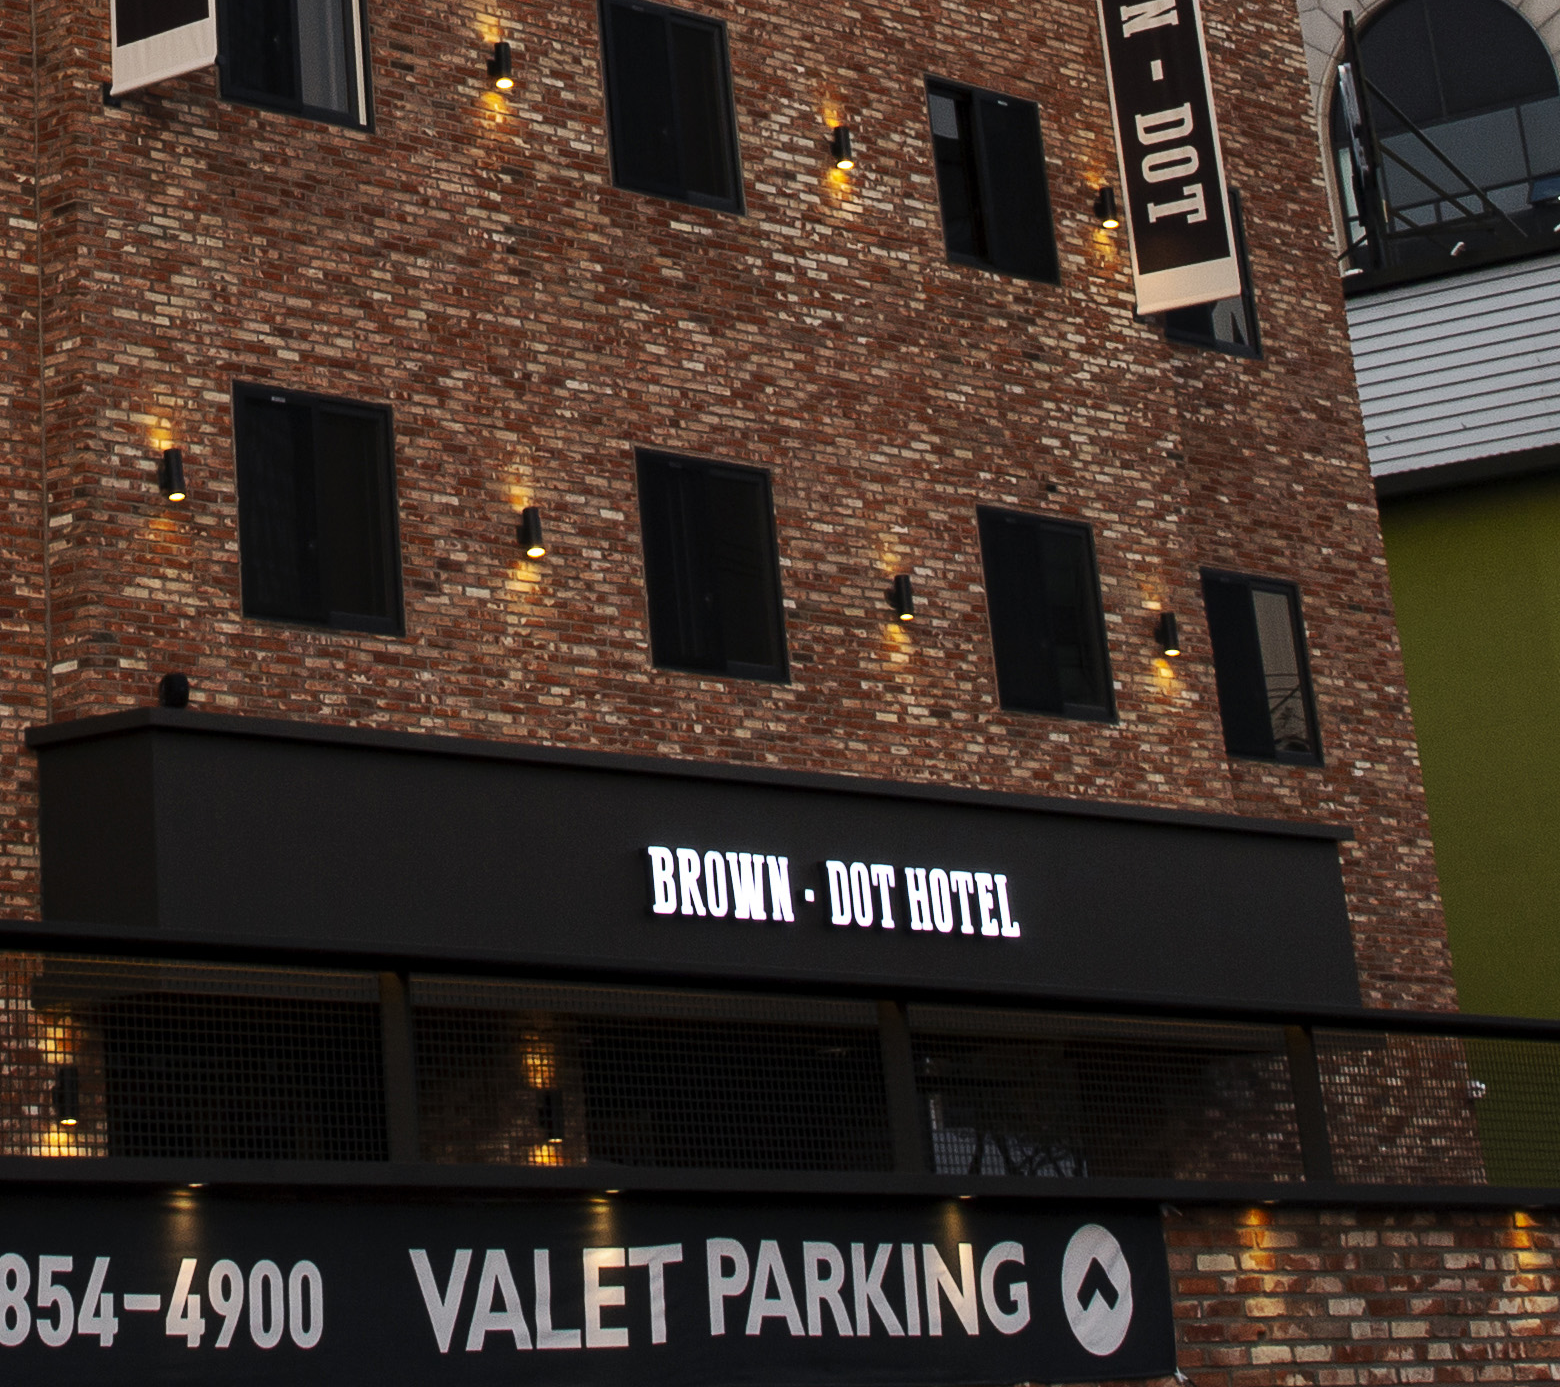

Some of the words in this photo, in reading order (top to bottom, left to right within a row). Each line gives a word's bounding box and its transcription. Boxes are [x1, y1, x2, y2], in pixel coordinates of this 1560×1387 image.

[1134, 102, 1208, 224] DOT
[647, 846, 795, 922] BROWN
[826, 860, 895, 929] DOT
[904, 867, 1021, 938] HOTEL
[408, 1243, 683, 1354] VALET
[706, 1237, 1030, 1337] PARKING
